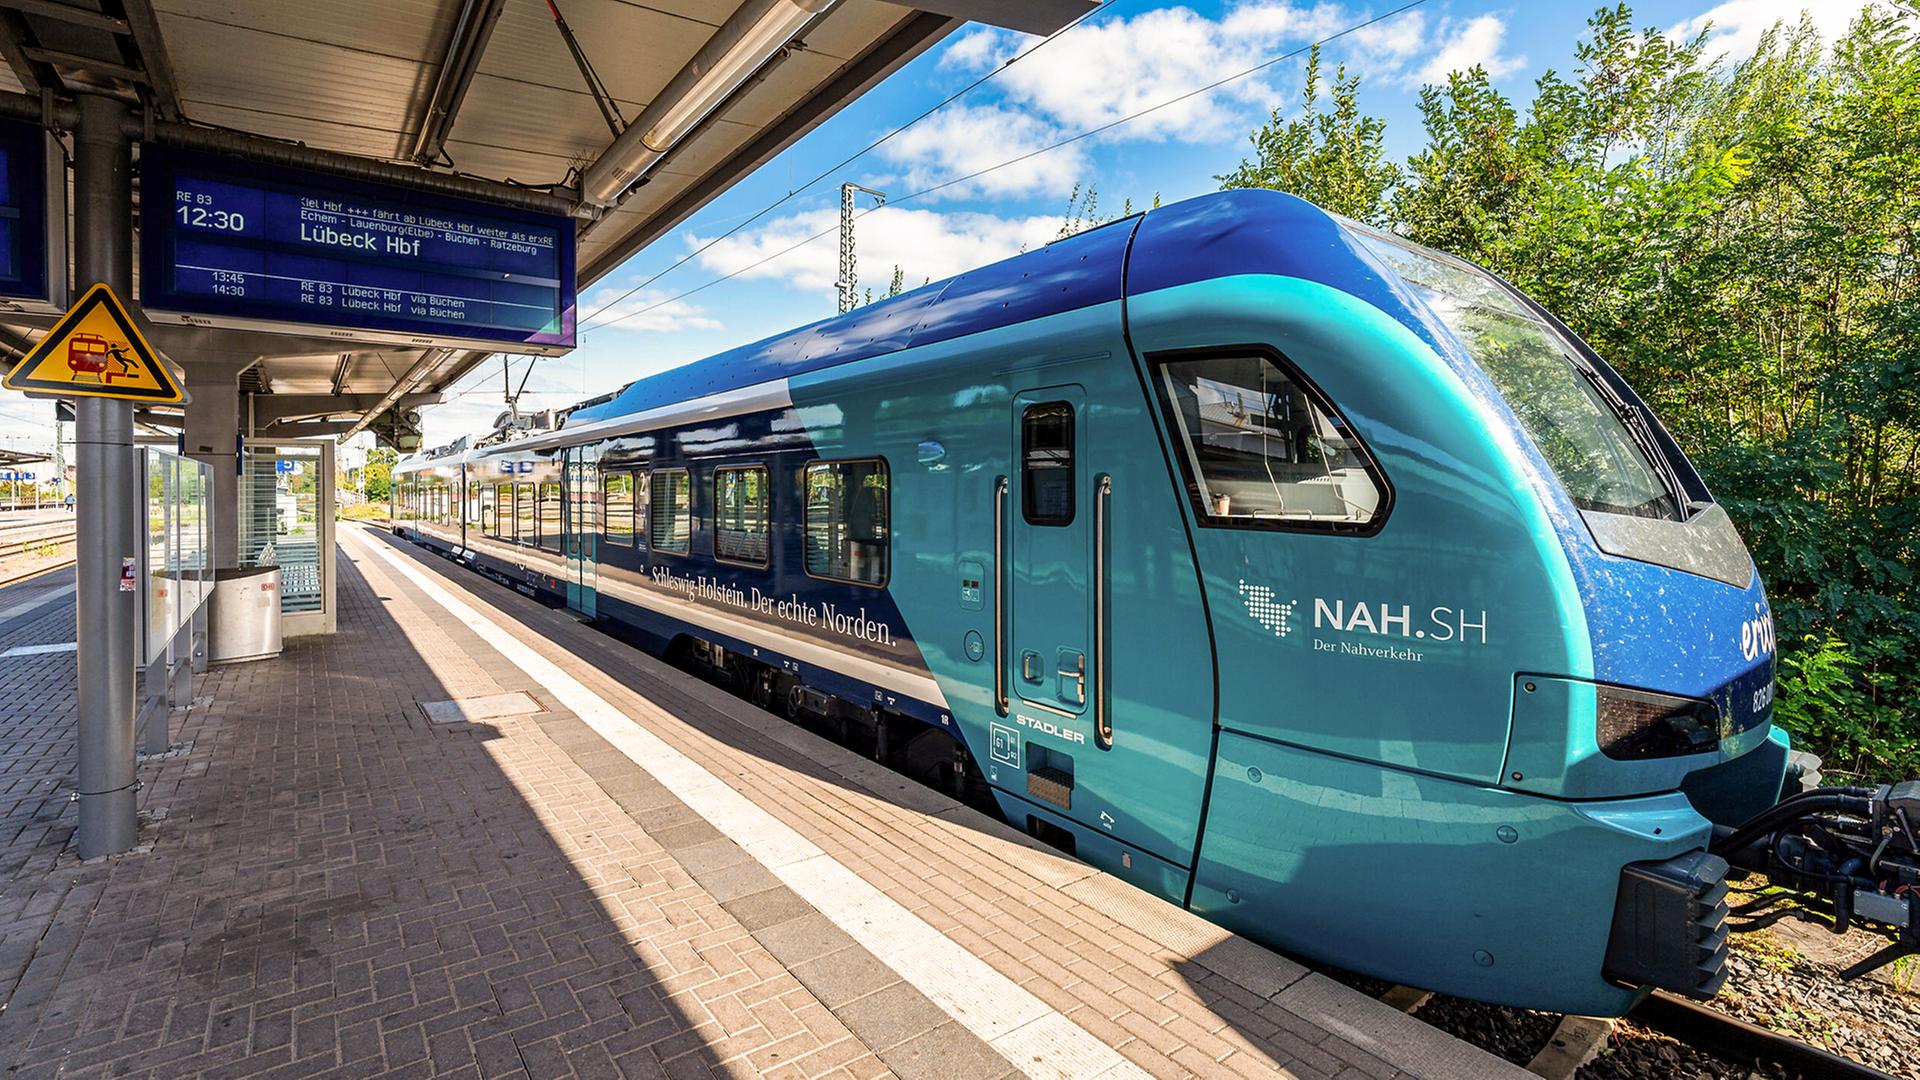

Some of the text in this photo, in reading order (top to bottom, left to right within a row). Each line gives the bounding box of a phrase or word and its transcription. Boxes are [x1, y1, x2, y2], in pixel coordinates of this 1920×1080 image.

[176, 191, 212, 205] RE 83
[177, 205, 244, 231] 12:30
[323, 201, 342, 212] Hbf
[404, 214, 415, 224] ab
[418, 216, 453, 230] Lübeck
[457, 222, 473, 233] Hbf
[477, 227, 508, 238] weiter
[512, 232, 525, 242] als
[301, 210, 337, 224] Echem
[490, 239, 537, 256] Ratzeburg
[301, 222, 420, 256] Lübeck Hbf
[212, 271, 245, 284] 13:45
[212, 284, 245, 297] 14:30
[301, 281, 314, 292] RE
[319, 284, 333, 294] 83
[341, 286, 380, 299] Lübeck
[384, 291, 401, 301] Hbf
[410, 294, 426, 305] via
[301, 293, 314, 304] RE
[319, 296, 333, 306] 83
[341, 298, 380, 311] Lübeck
[384, 303, 401, 313] Hbf
[410, 306, 426, 316] via
[652, 566, 897, 647] Schleswig-Holstein. Der echte Norden.
[1314, 598, 1487, 644] NAH.SH
[1313, 639, 1423, 662] Der Nahverkehr
[1016, 714, 1085, 745] STADLER
